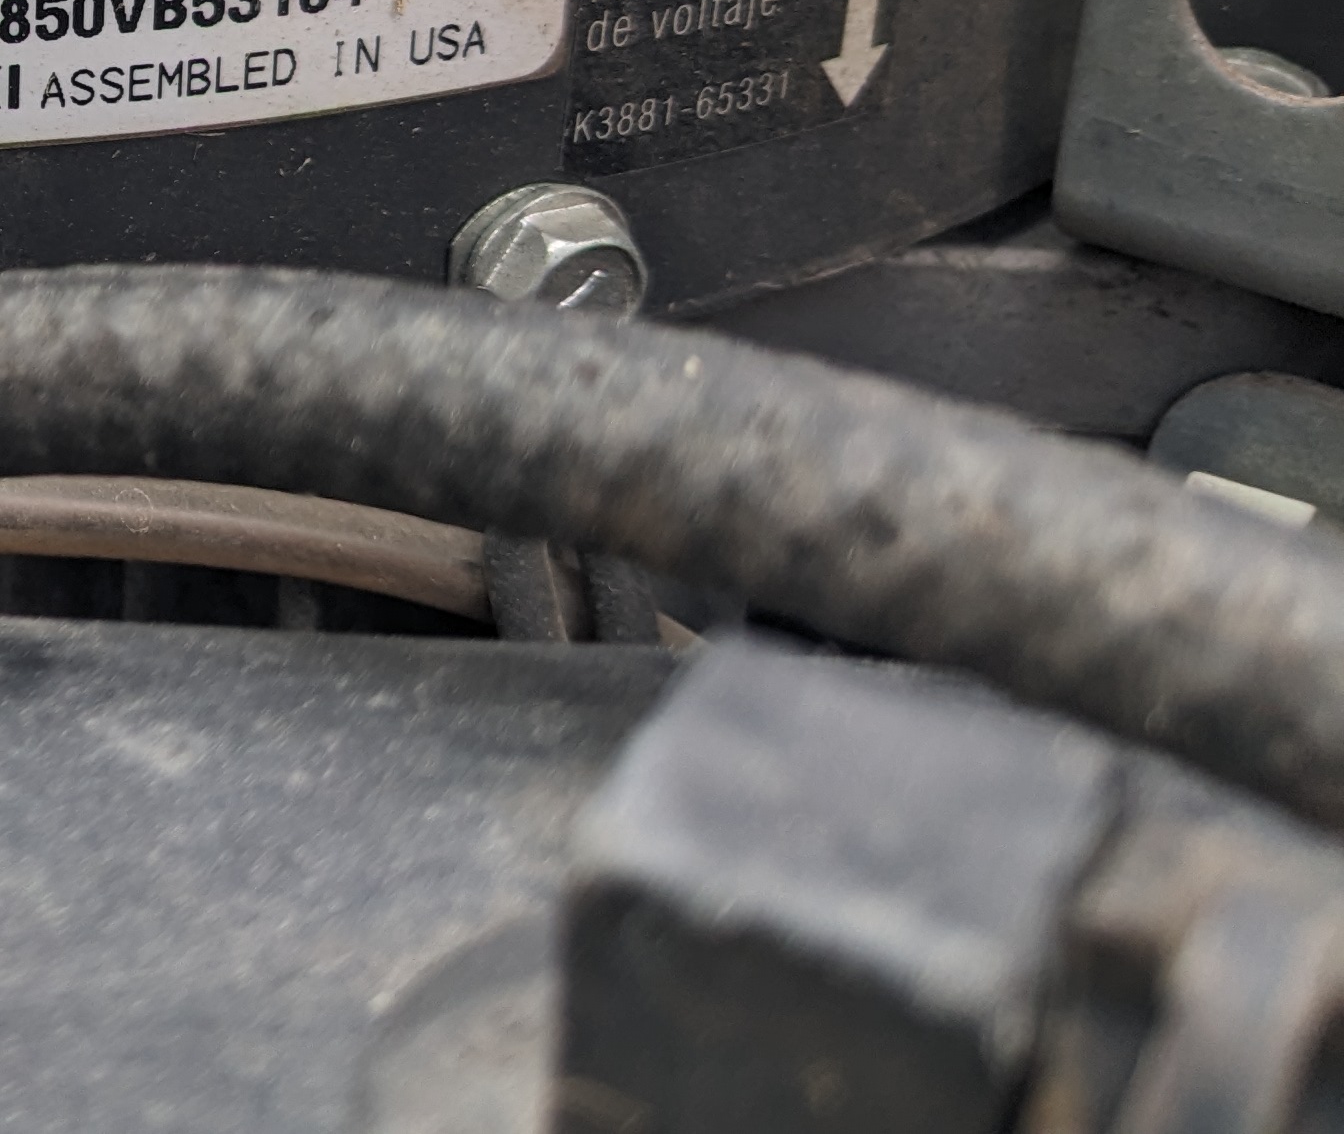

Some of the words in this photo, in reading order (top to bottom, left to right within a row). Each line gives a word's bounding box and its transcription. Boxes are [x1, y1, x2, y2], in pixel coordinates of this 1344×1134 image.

[41, 48, 297, 108] ASSEMBLED
[331, 38, 380, 79] IN
[408, 24, 488, 67] USA
[587, 12, 634, 53] de
[573, 71, 792, 144] K3881-65331
